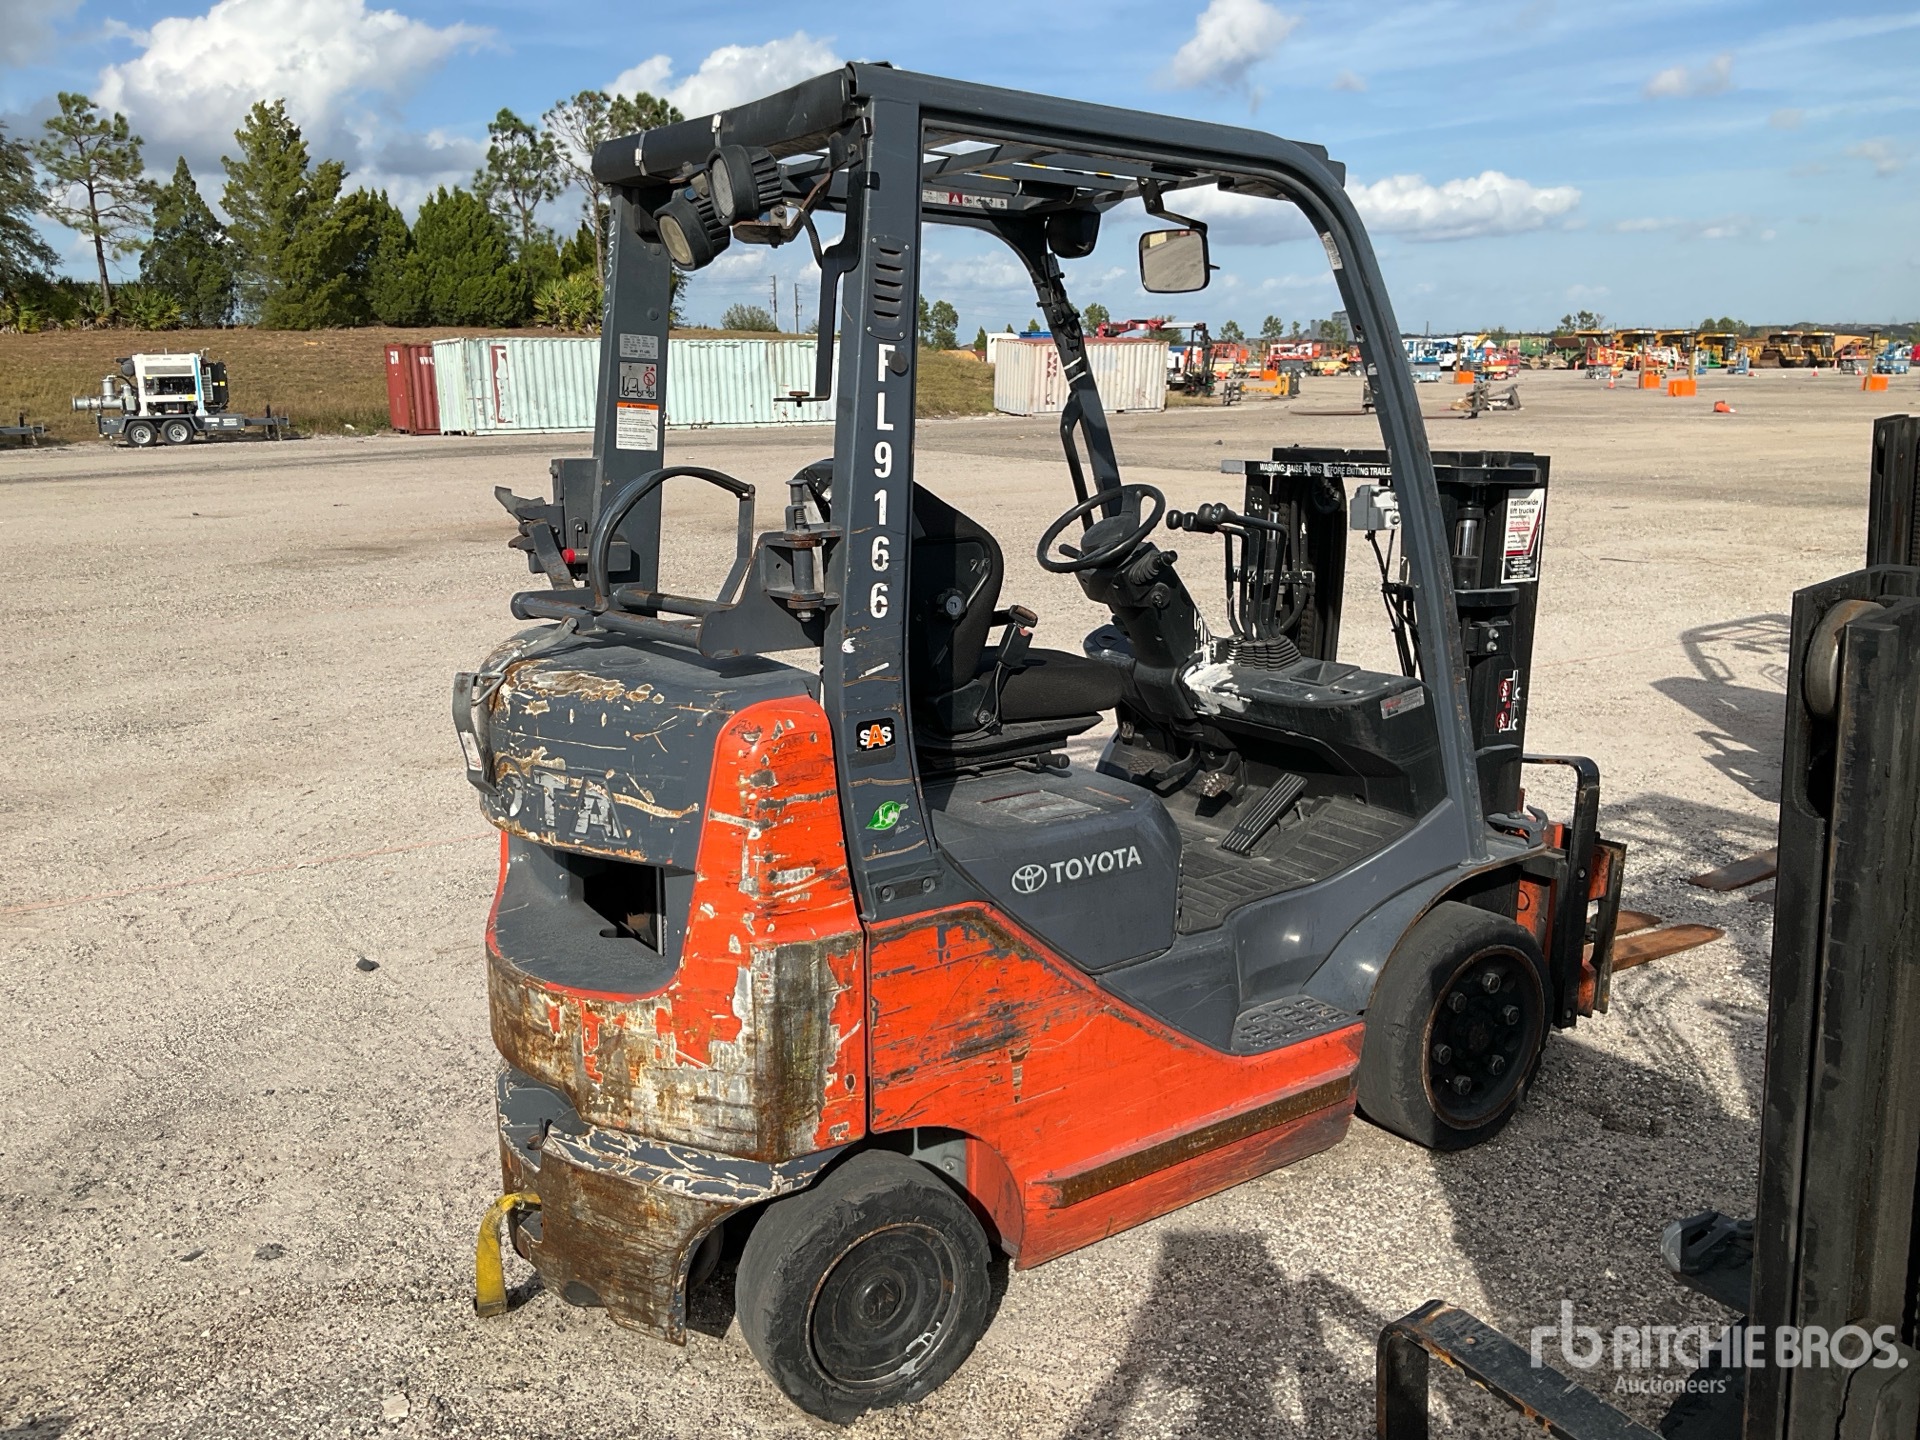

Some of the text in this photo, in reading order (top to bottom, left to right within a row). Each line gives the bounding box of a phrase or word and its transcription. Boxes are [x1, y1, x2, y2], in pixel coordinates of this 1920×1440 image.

[870, 343, 896, 619] FL9166
[1369, 467, 1392, 476] TRAILE
[1510, 499, 1539, 507] nationwide
[860, 724, 892, 748] SAS
[1050, 846, 1142, 883] TOYOTA
